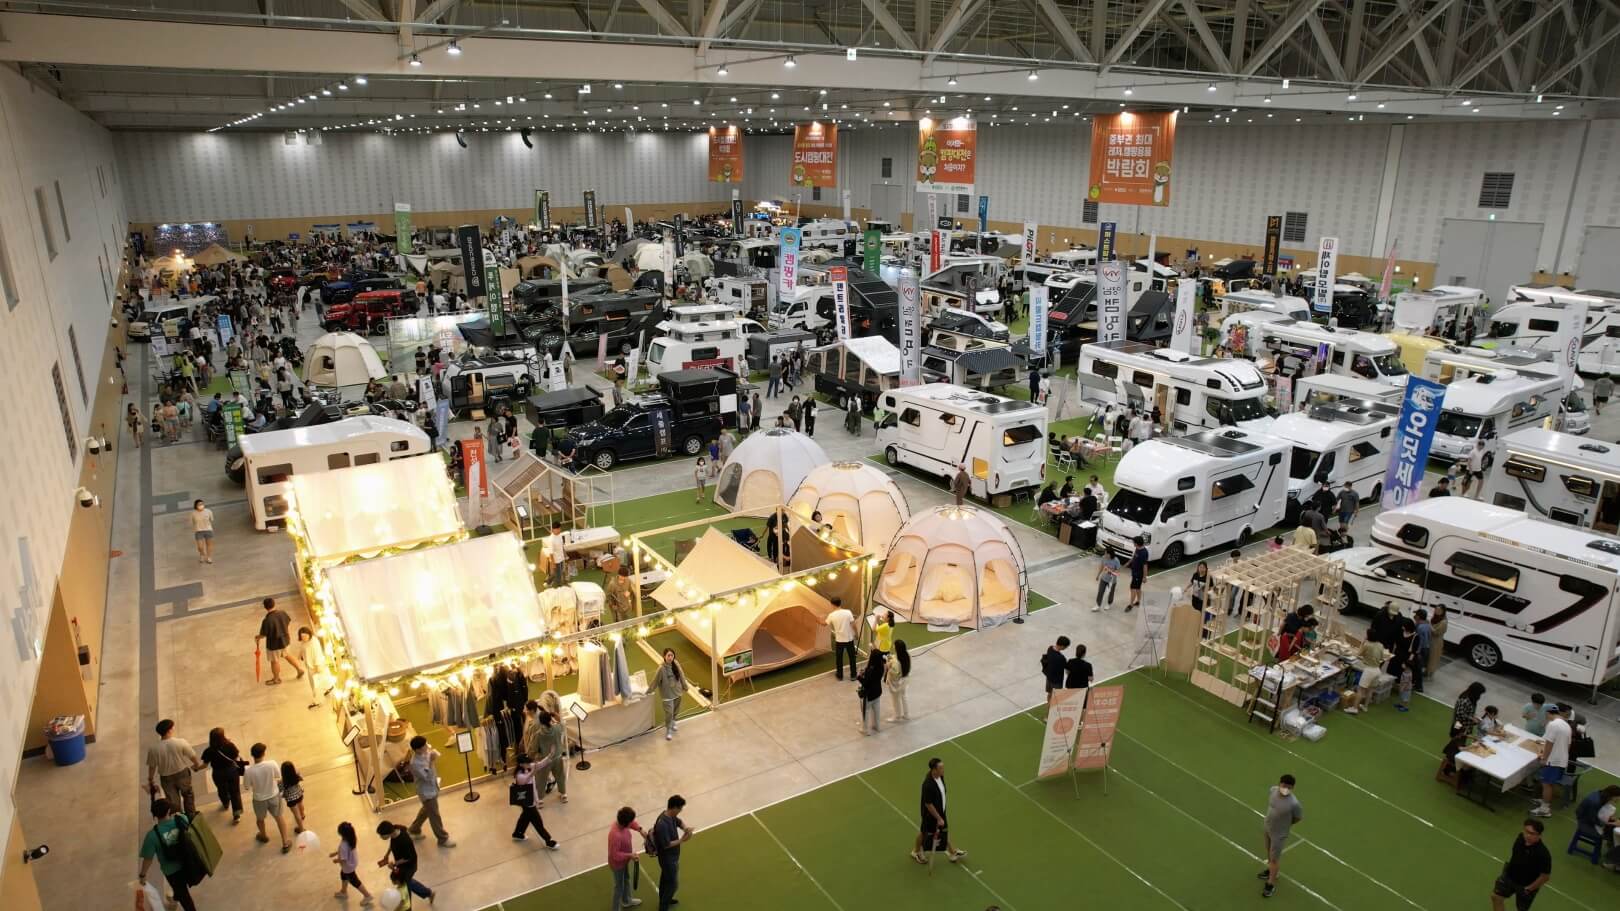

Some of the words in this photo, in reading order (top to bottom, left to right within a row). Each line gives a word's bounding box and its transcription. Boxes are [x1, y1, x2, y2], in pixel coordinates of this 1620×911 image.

[1108, 134, 1134, 145] 중부권
[1136, 134, 1153, 145] 최대
[795, 151, 834, 164] 도시캠핑대전
[940, 149, 972, 162] 캠핑대전은
[1107, 159, 1150, 179] 박람회
[783, 253, 795, 291] 캠핑카
